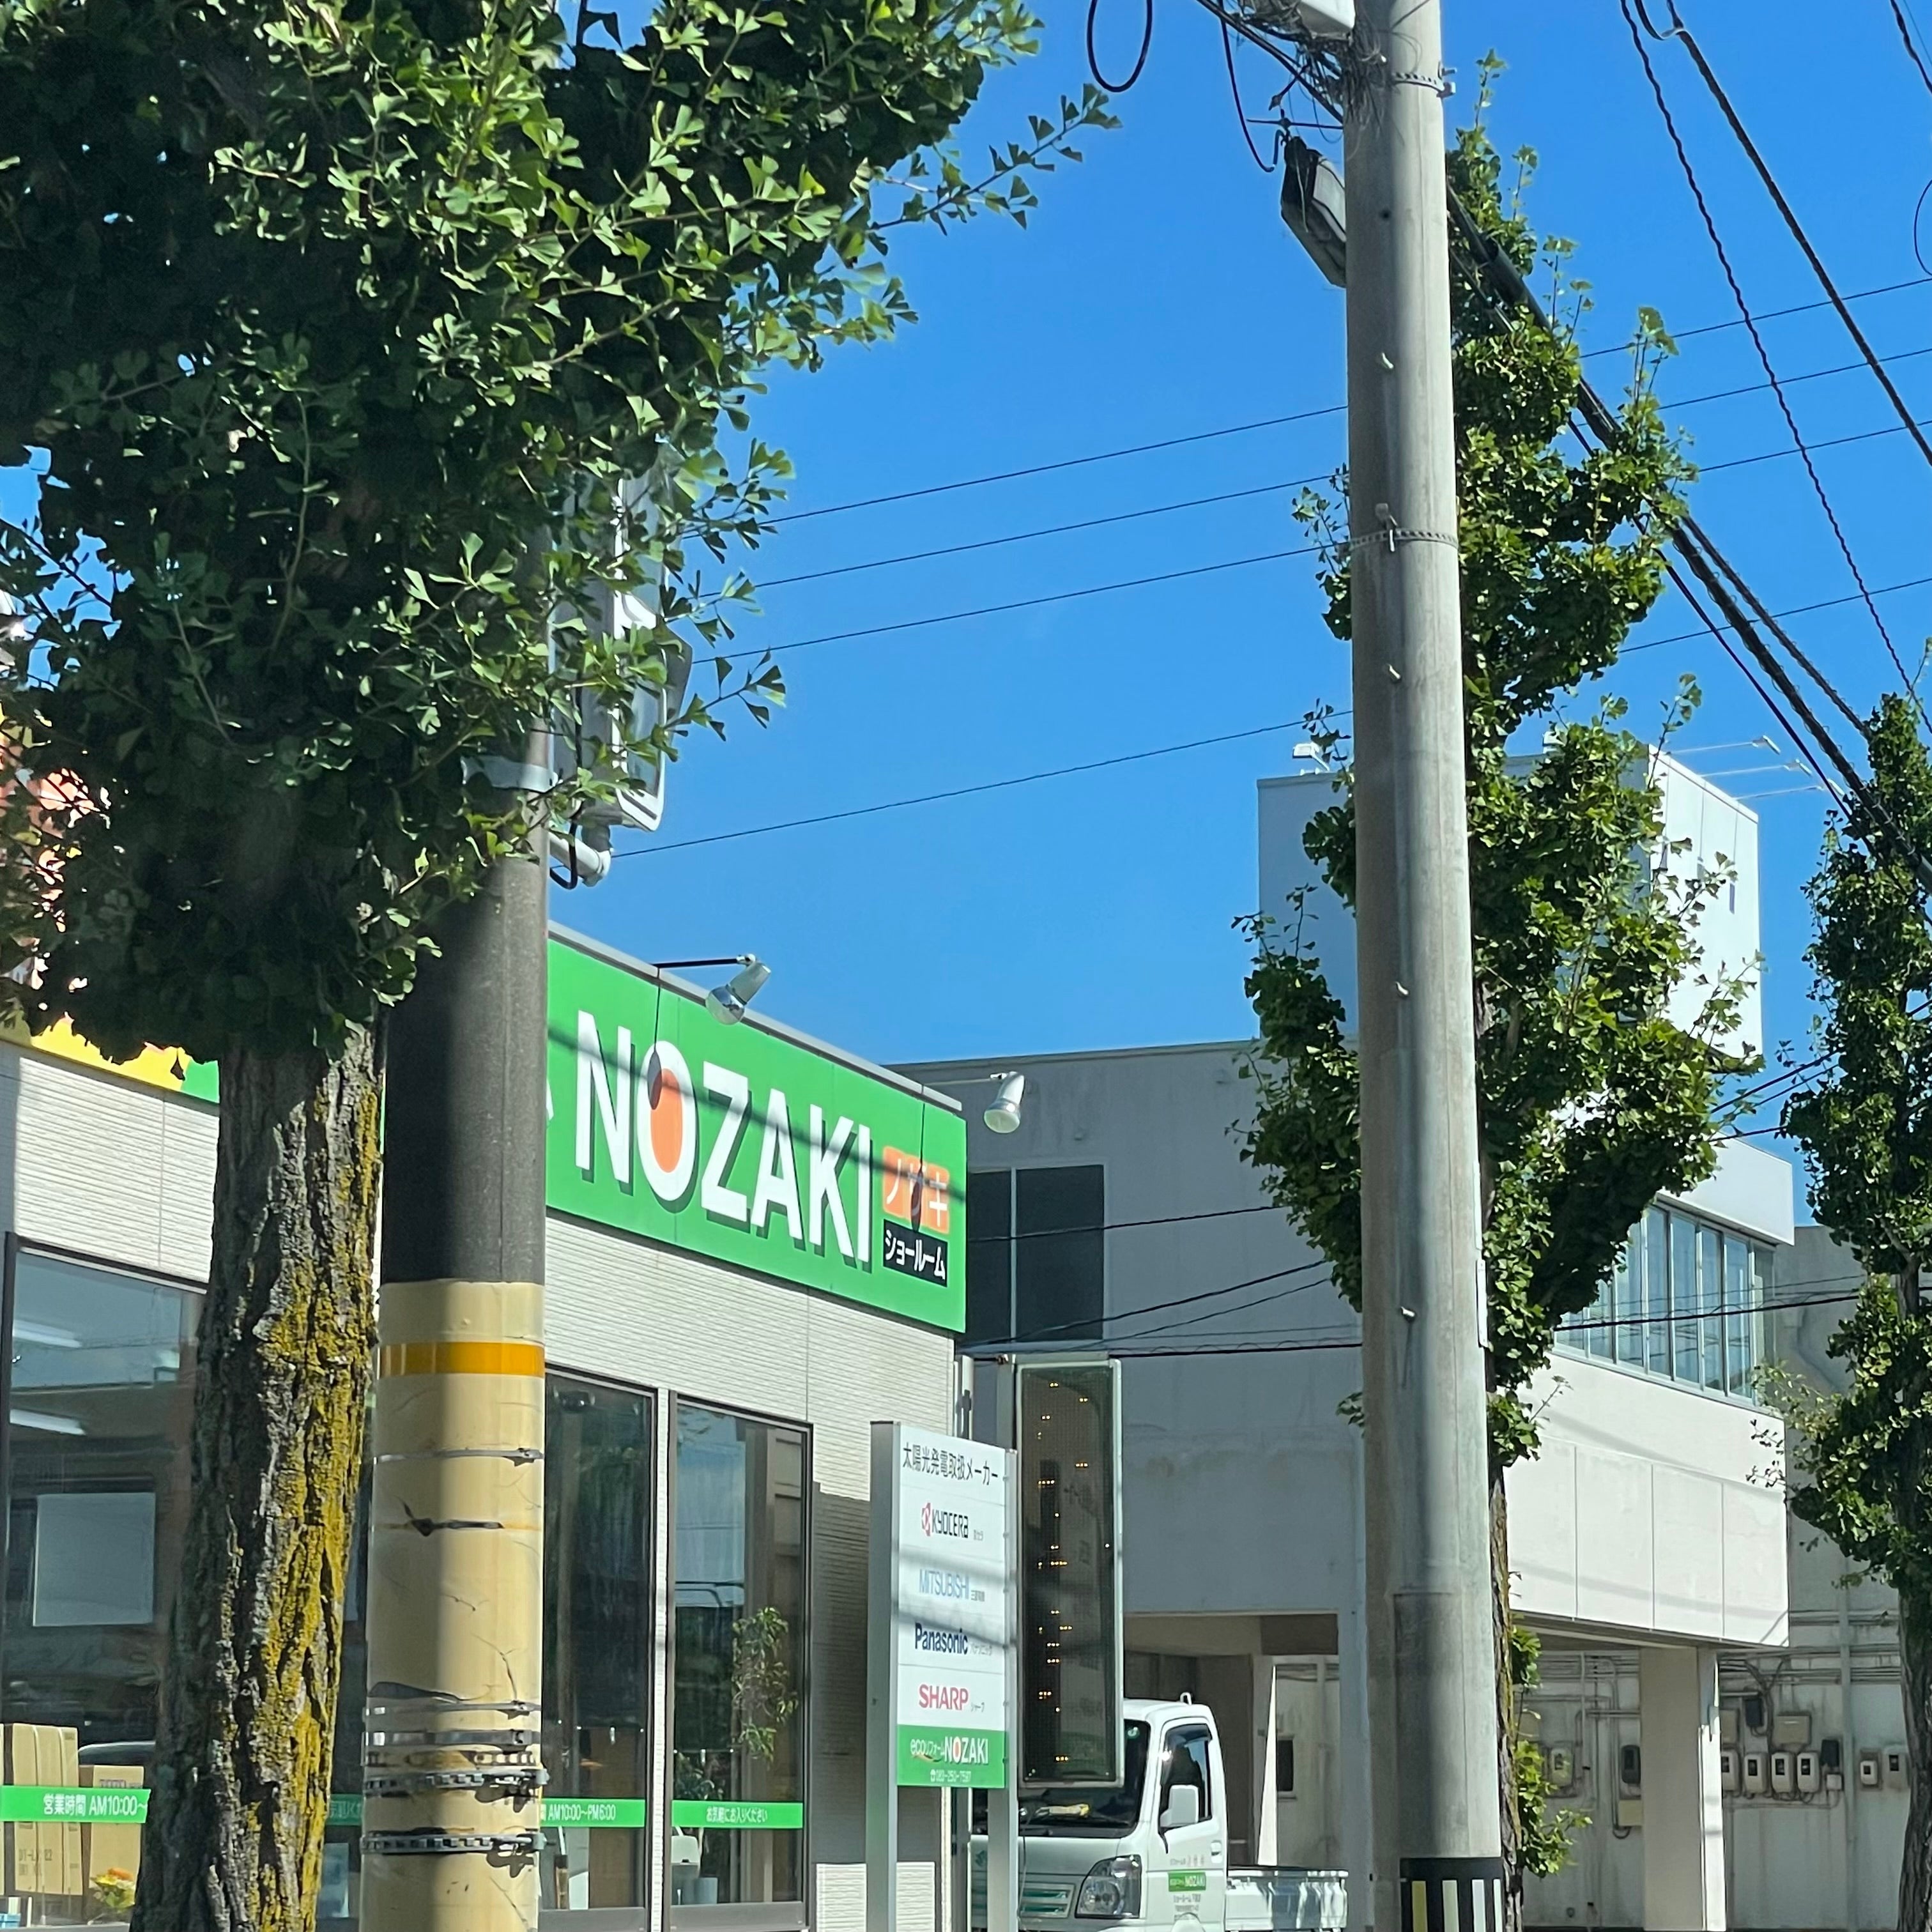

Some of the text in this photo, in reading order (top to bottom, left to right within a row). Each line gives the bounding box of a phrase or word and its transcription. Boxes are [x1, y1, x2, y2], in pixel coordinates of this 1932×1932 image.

[576, 1009, 871, 1264] NOZAKI
[885, 1229, 946, 1280] ショールーム
[902, 1441, 998, 1485] 太陽光発電取扱メーカー
[919, 1568, 970, 1600] MITSUBISHI
[914, 1622, 969, 1655] Panasonic
[918, 1683, 969, 1711] SHARP
[944, 1736, 988, 1764] NOZAKI
[43, 1793, 86, 1817] 営業時間
